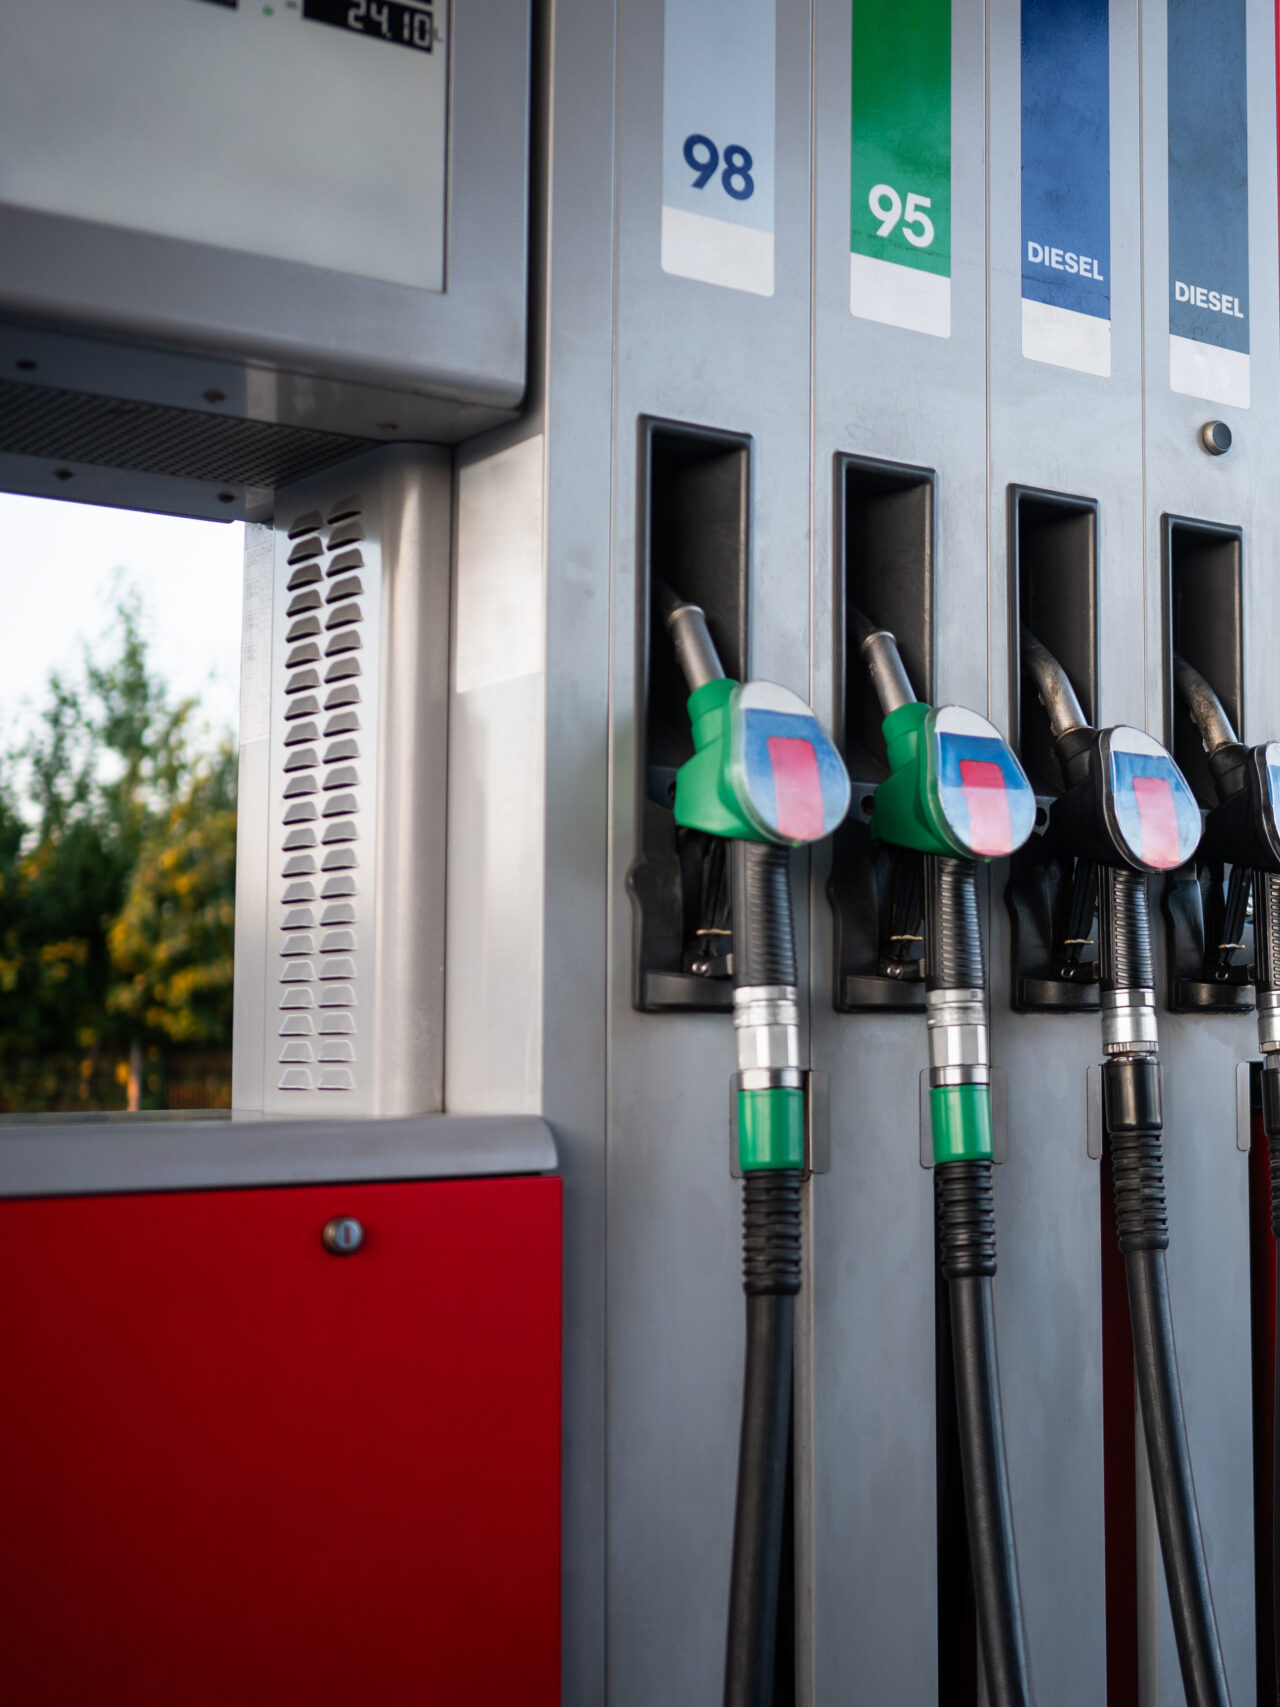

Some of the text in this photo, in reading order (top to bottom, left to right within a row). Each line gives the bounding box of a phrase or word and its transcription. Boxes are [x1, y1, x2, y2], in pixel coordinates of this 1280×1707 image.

[683, 133, 754, 201] 98
[868, 183, 934, 248] 95
[1027, 240, 1104, 281] DIESEL
[1175, 280, 1244, 319] DIESEL
